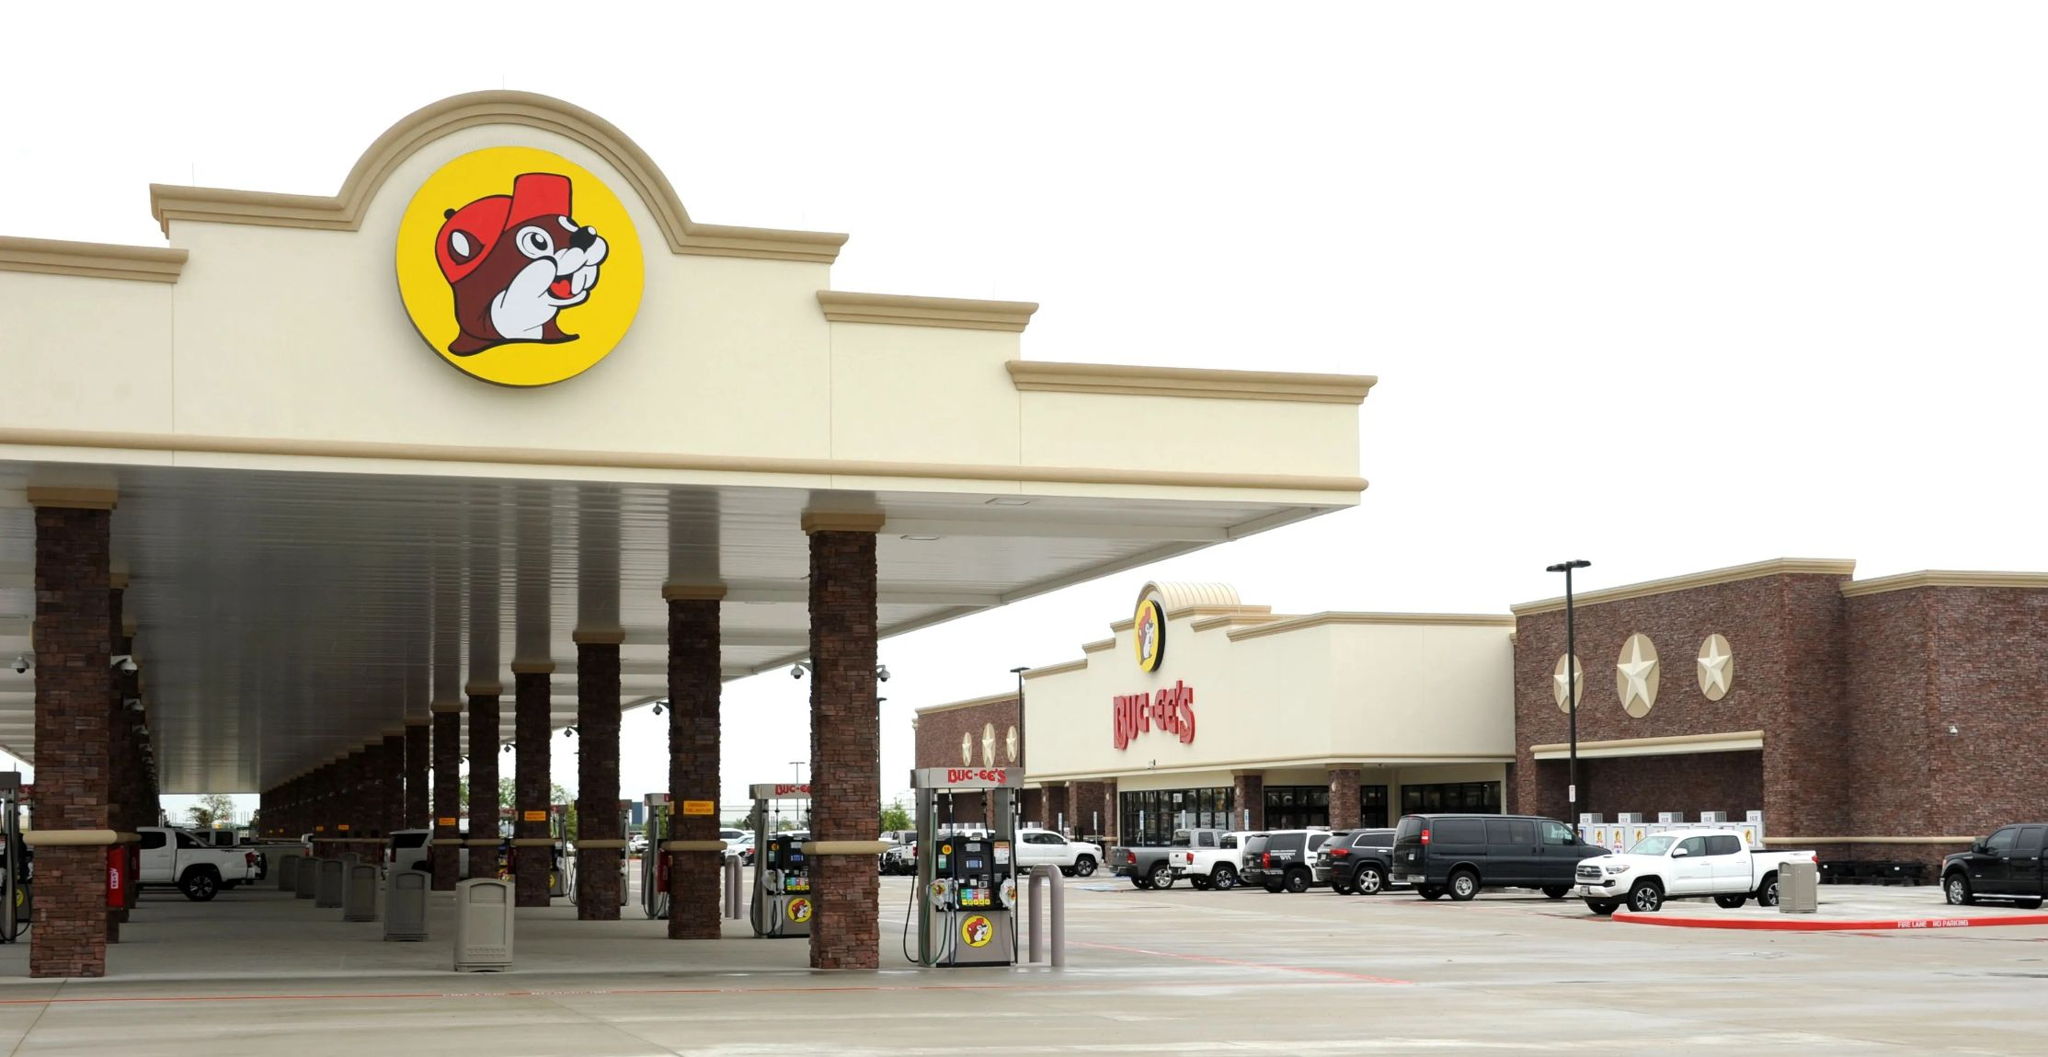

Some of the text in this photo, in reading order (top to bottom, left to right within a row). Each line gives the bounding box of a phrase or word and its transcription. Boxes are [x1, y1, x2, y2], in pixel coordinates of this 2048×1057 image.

[1113, 680, 1195, 750] BUC-EE'S
[948, 768, 1006, 783] BUC-EE'S
[775, 784, 812, 795] BUC-EE
[1898, 919, 1969, 928] FIRE LANE NO PARKING
